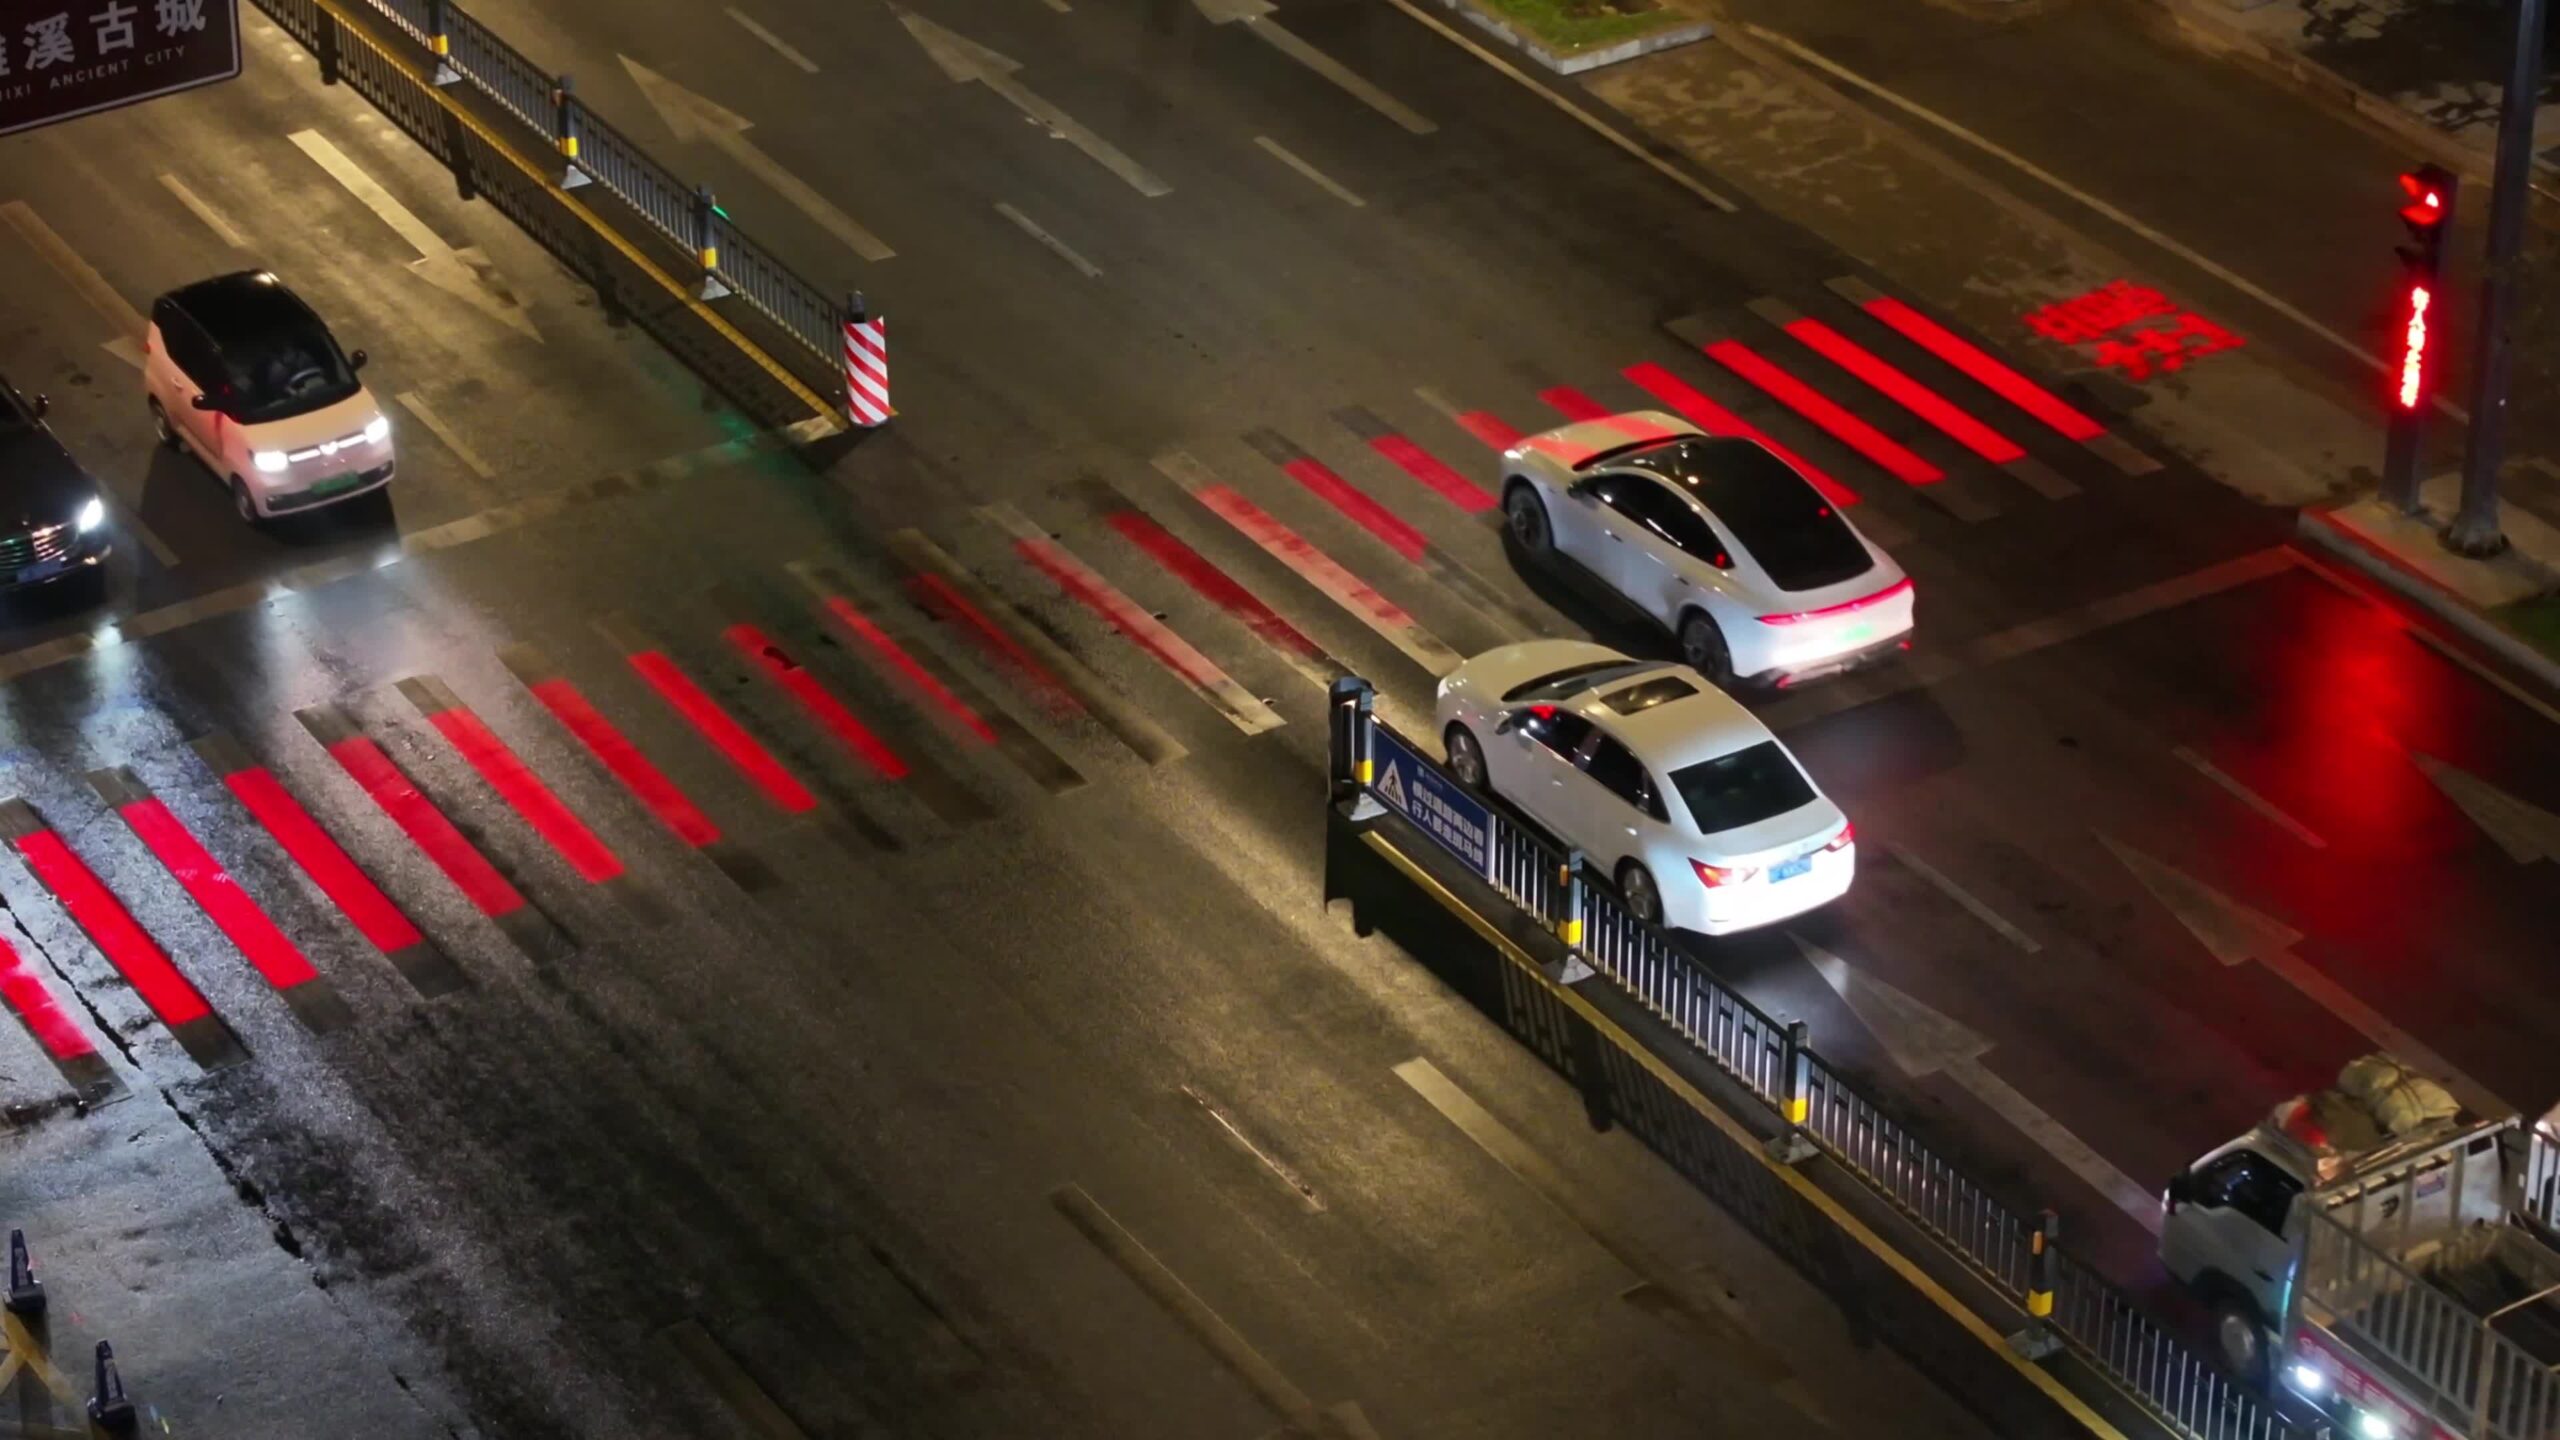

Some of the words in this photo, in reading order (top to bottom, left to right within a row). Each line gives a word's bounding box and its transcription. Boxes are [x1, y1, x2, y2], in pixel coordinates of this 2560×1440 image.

[0, 0, 207, 76] 溪古城
[0, 83, 31, 101] IXI
[50, 59, 130, 89] ANCIENT
[145, 45, 186, 65] CITY
